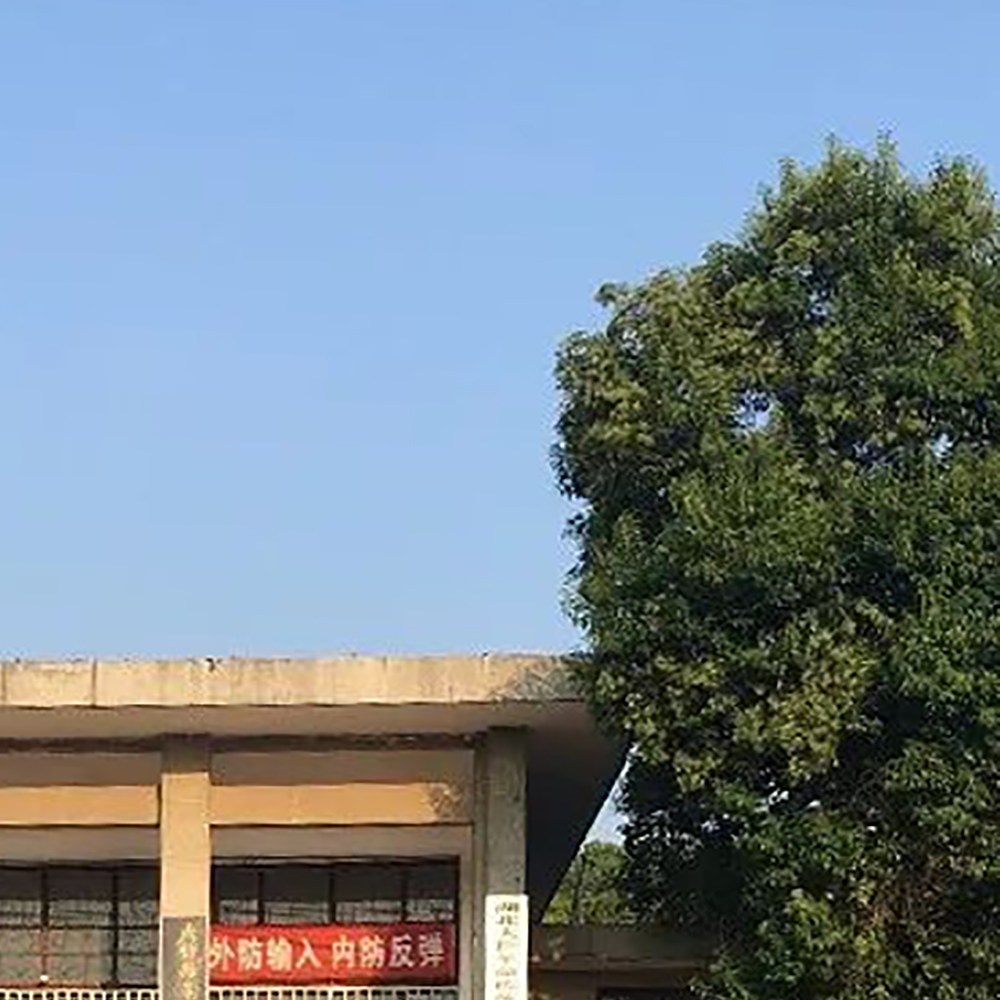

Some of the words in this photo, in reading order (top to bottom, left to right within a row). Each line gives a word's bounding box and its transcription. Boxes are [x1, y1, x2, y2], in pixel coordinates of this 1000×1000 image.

[207, 935, 322, 971] 外防输入
[331, 933, 445, 969] 内防反弹
